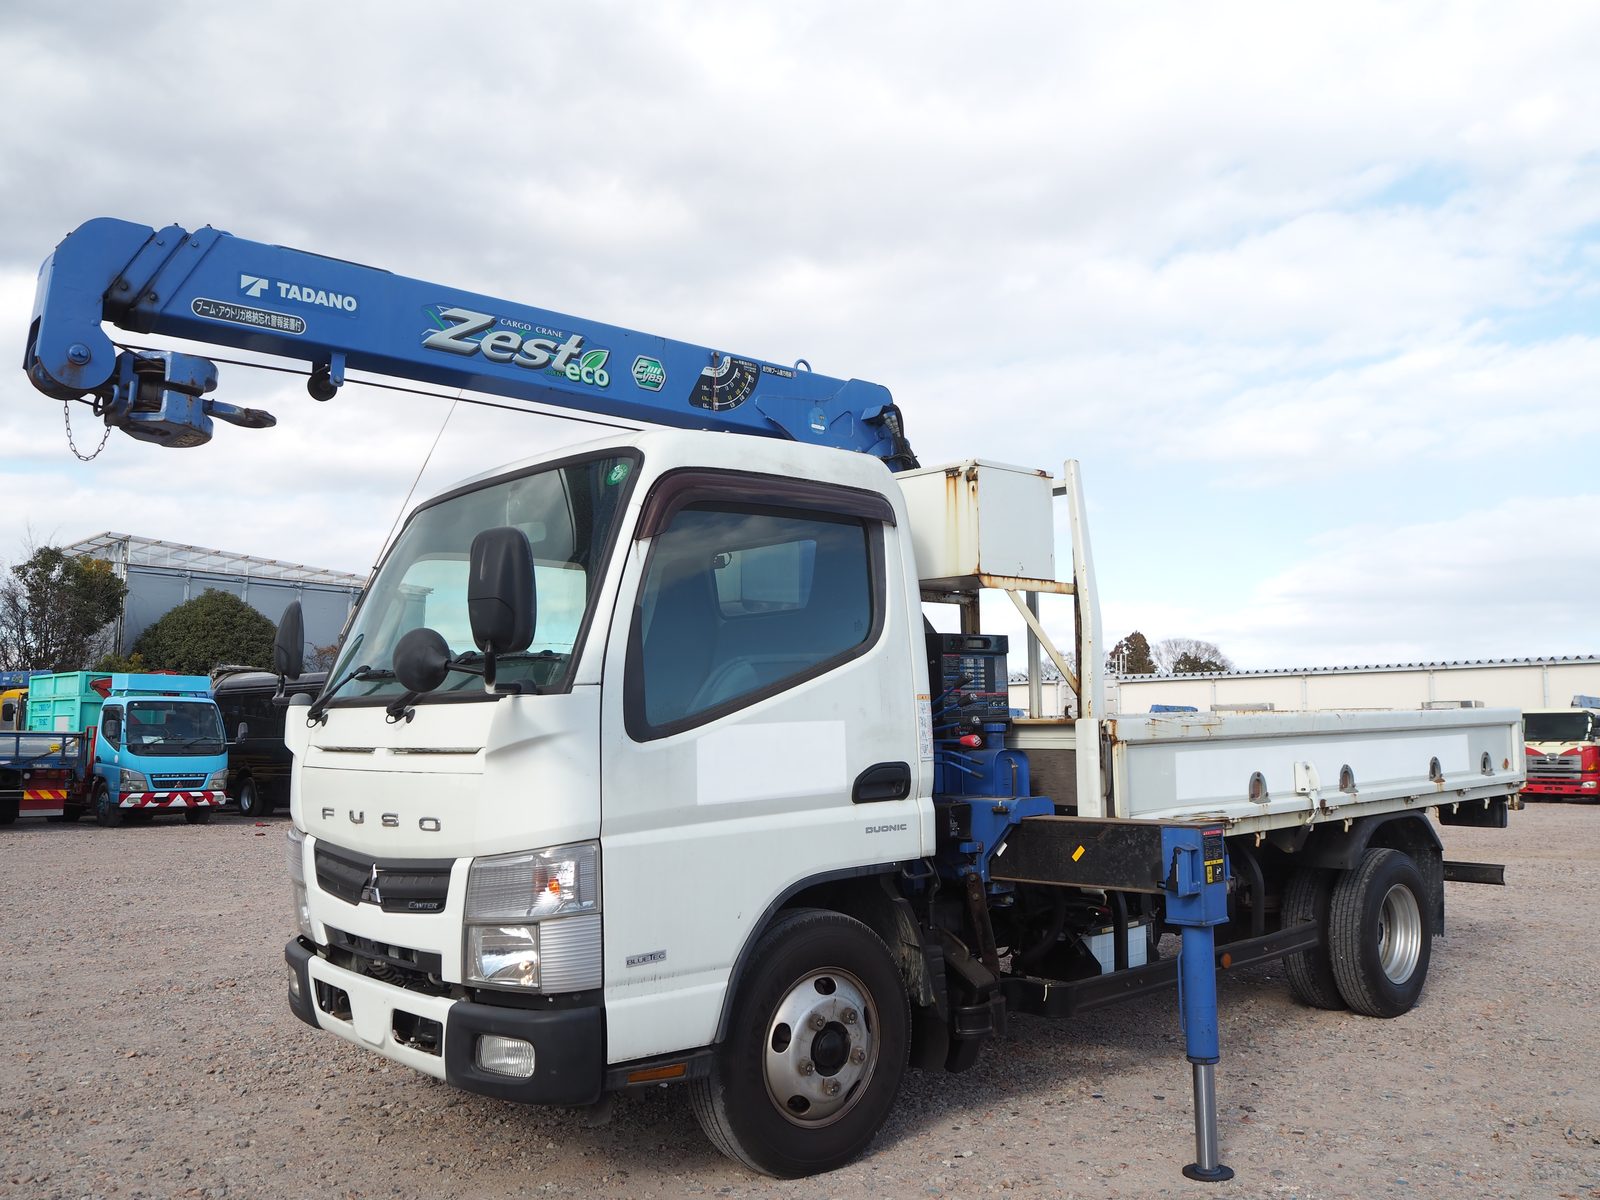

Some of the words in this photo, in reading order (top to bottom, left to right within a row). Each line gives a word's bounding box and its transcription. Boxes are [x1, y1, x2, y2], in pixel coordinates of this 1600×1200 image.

[277, 282, 357, 312] TADANO
[421, 308, 583, 371] Zest
[501, 318, 532, 331] CARGO
[535, 326, 563, 338] CRANE
[565, 363, 609, 387] eco
[322, 807, 441, 832] FUSO
[865, 823, 907, 834] DUONIC
[626, 953, 665, 965] BLUETEC
